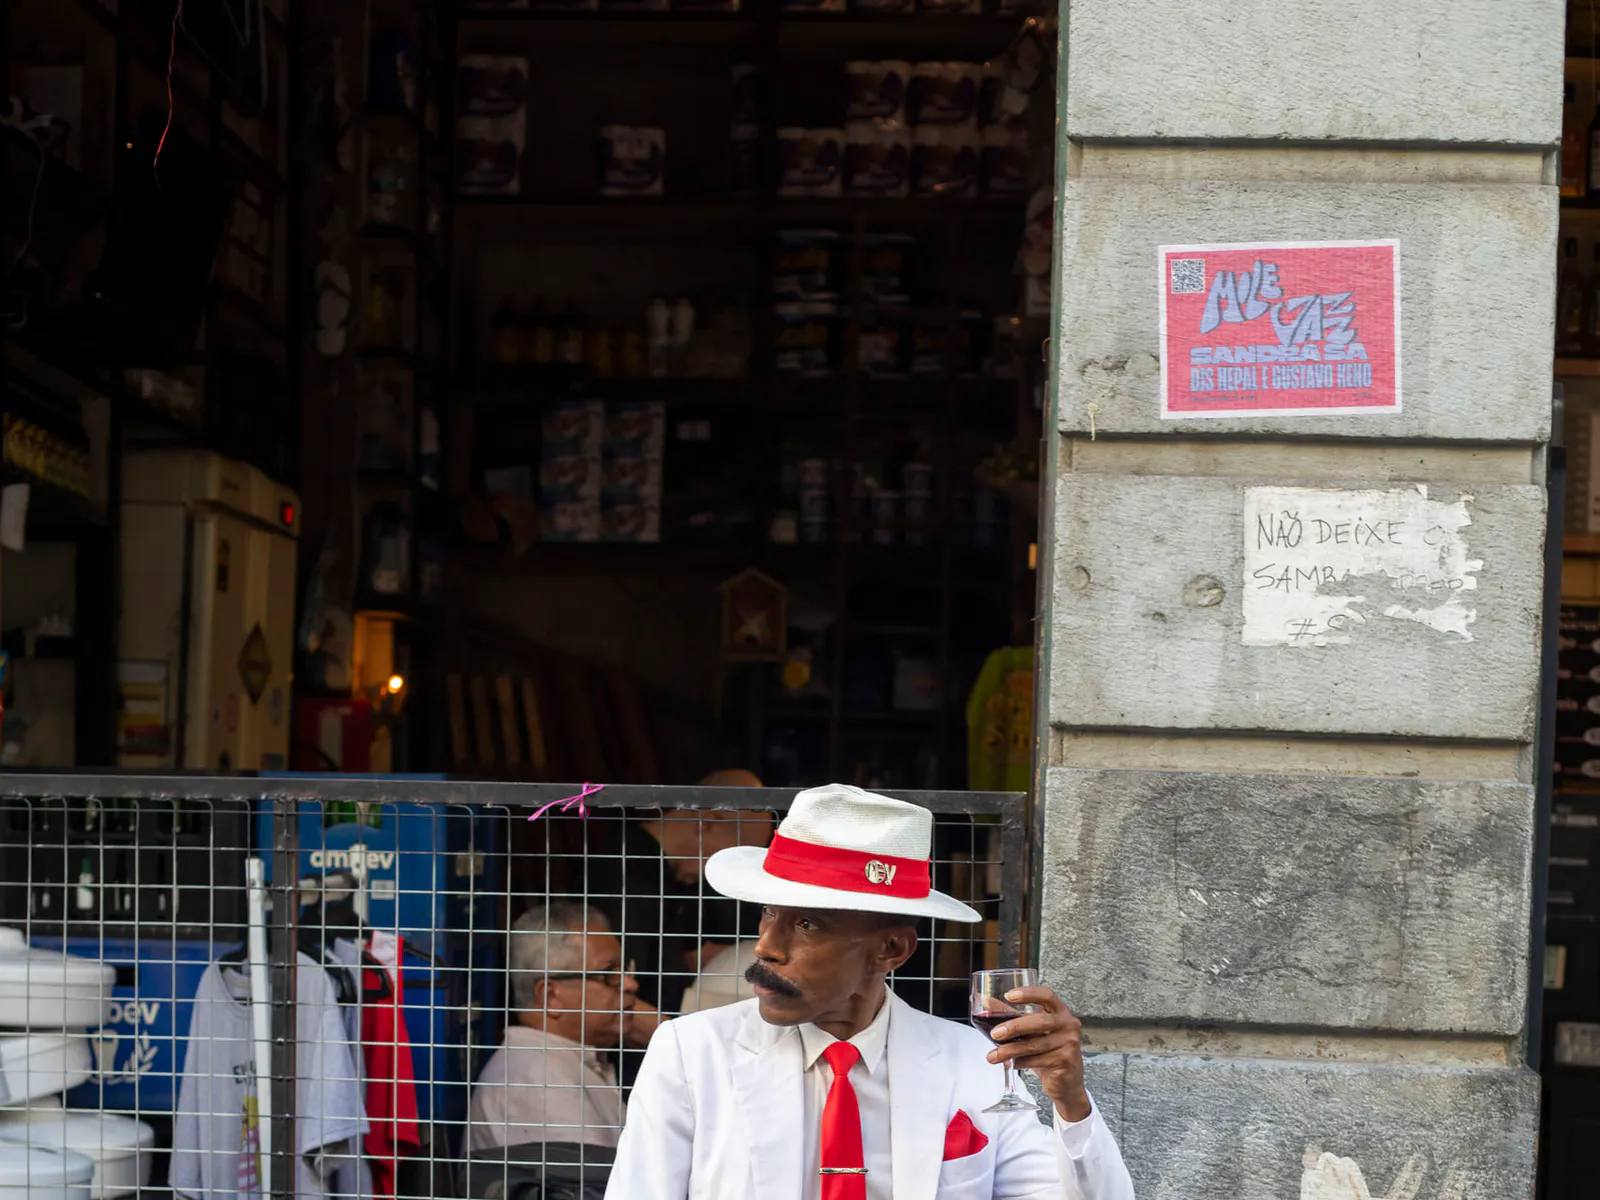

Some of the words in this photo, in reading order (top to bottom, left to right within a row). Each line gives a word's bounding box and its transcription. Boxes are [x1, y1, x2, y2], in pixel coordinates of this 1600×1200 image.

[1190, 343, 1322, 364] SANDRA
[1262, 365, 1270, 390] E
[1272, 363, 1333, 391] GUSTAVO
[1257, 510, 1303, 550] NÃO
[309, 850, 395, 870] amev
